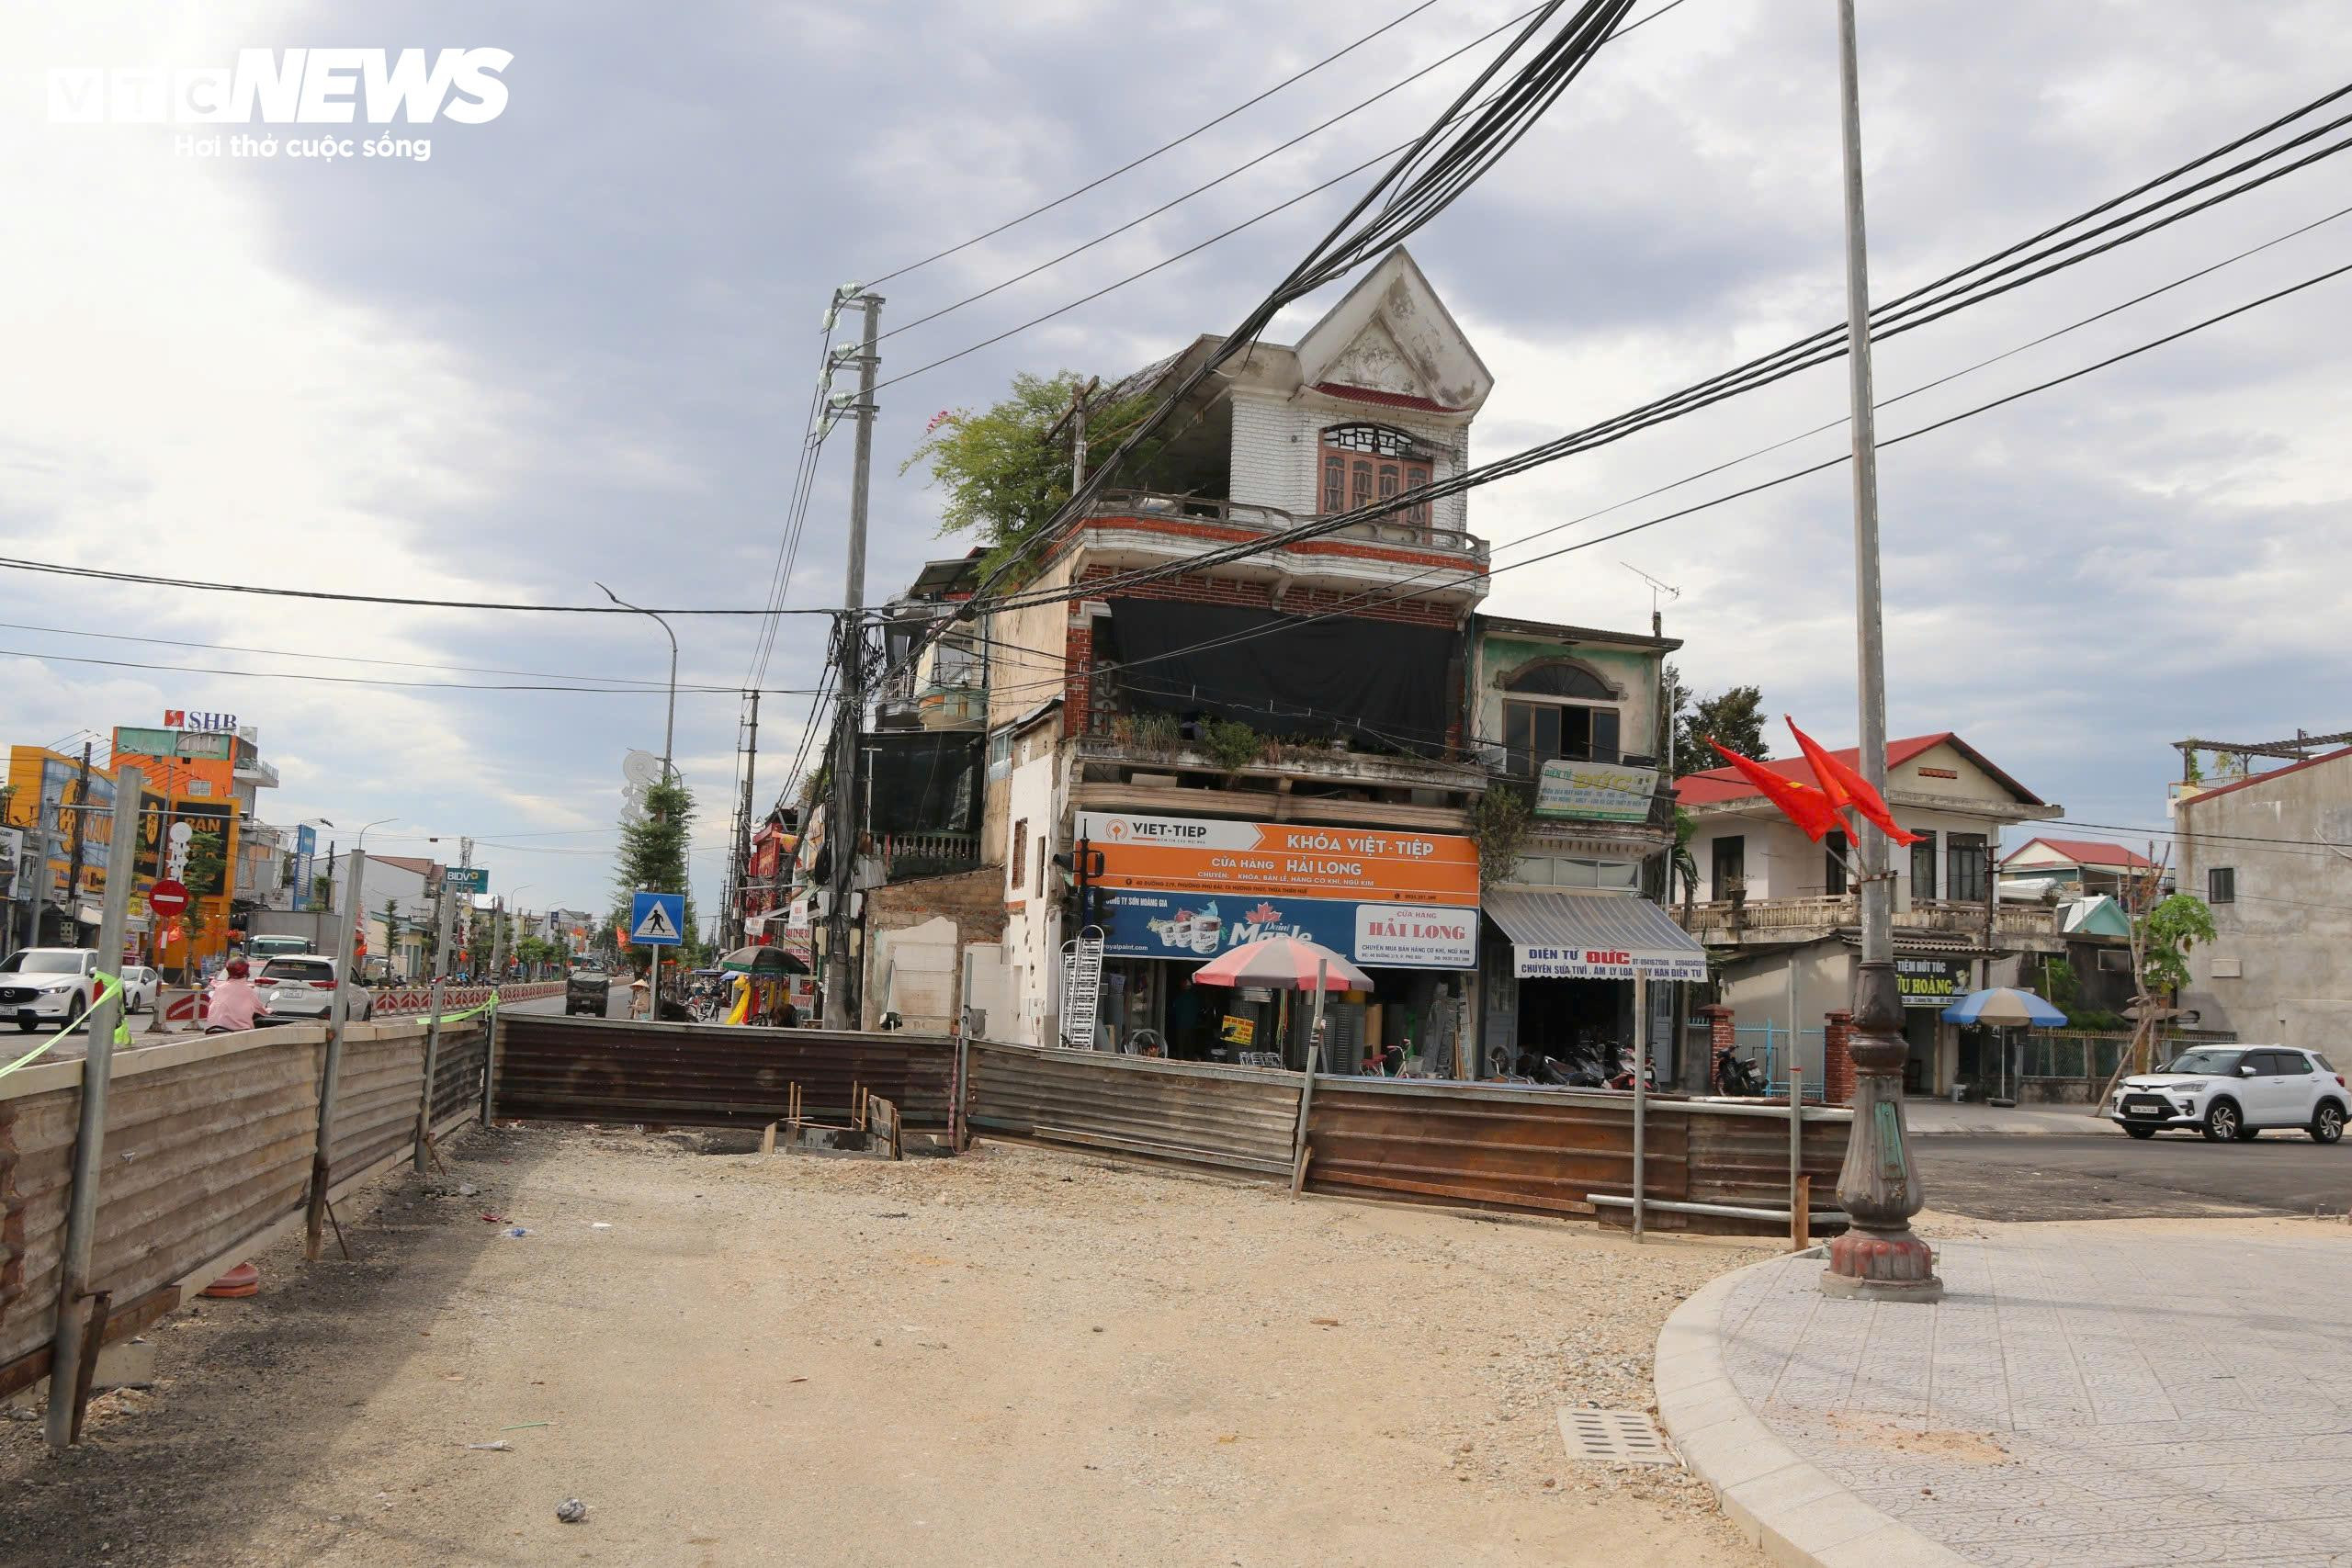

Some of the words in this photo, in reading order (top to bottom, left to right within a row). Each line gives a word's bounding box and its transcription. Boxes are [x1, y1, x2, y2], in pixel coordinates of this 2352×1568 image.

[188, 711, 237, 730] SHB
[1132, 822, 1207, 838] VIET-TIEP
[1287, 832, 1341, 852] KHÓA
[1212, 856, 1237, 868] CỬA
[1240, 857, 1275, 870] HÀNG
[1286, 855, 1315, 874] HẢI
[1317, 861, 1362, 875] LONG
[447, 871, 470, 881] BIDV
[1396, 909, 1413, 918] CỬA
[1416, 911, 1437, 919] HÀNG
[1368, 918, 1408, 937] HẢI
[1414, 923, 1465, 940] LONG
[1529, 948, 1558, 960] ĐIỆN
[1562, 948, 1579, 960] TỬ
[1586, 948, 1631, 964] ĐỨC
[1521, 964, 1552, 974] CHUYÊN
[1555, 964, 1570, 975] SỬA
[1896, 959, 1916, 974] TIỆM
[1932, 960, 1946, 973] TÓC
